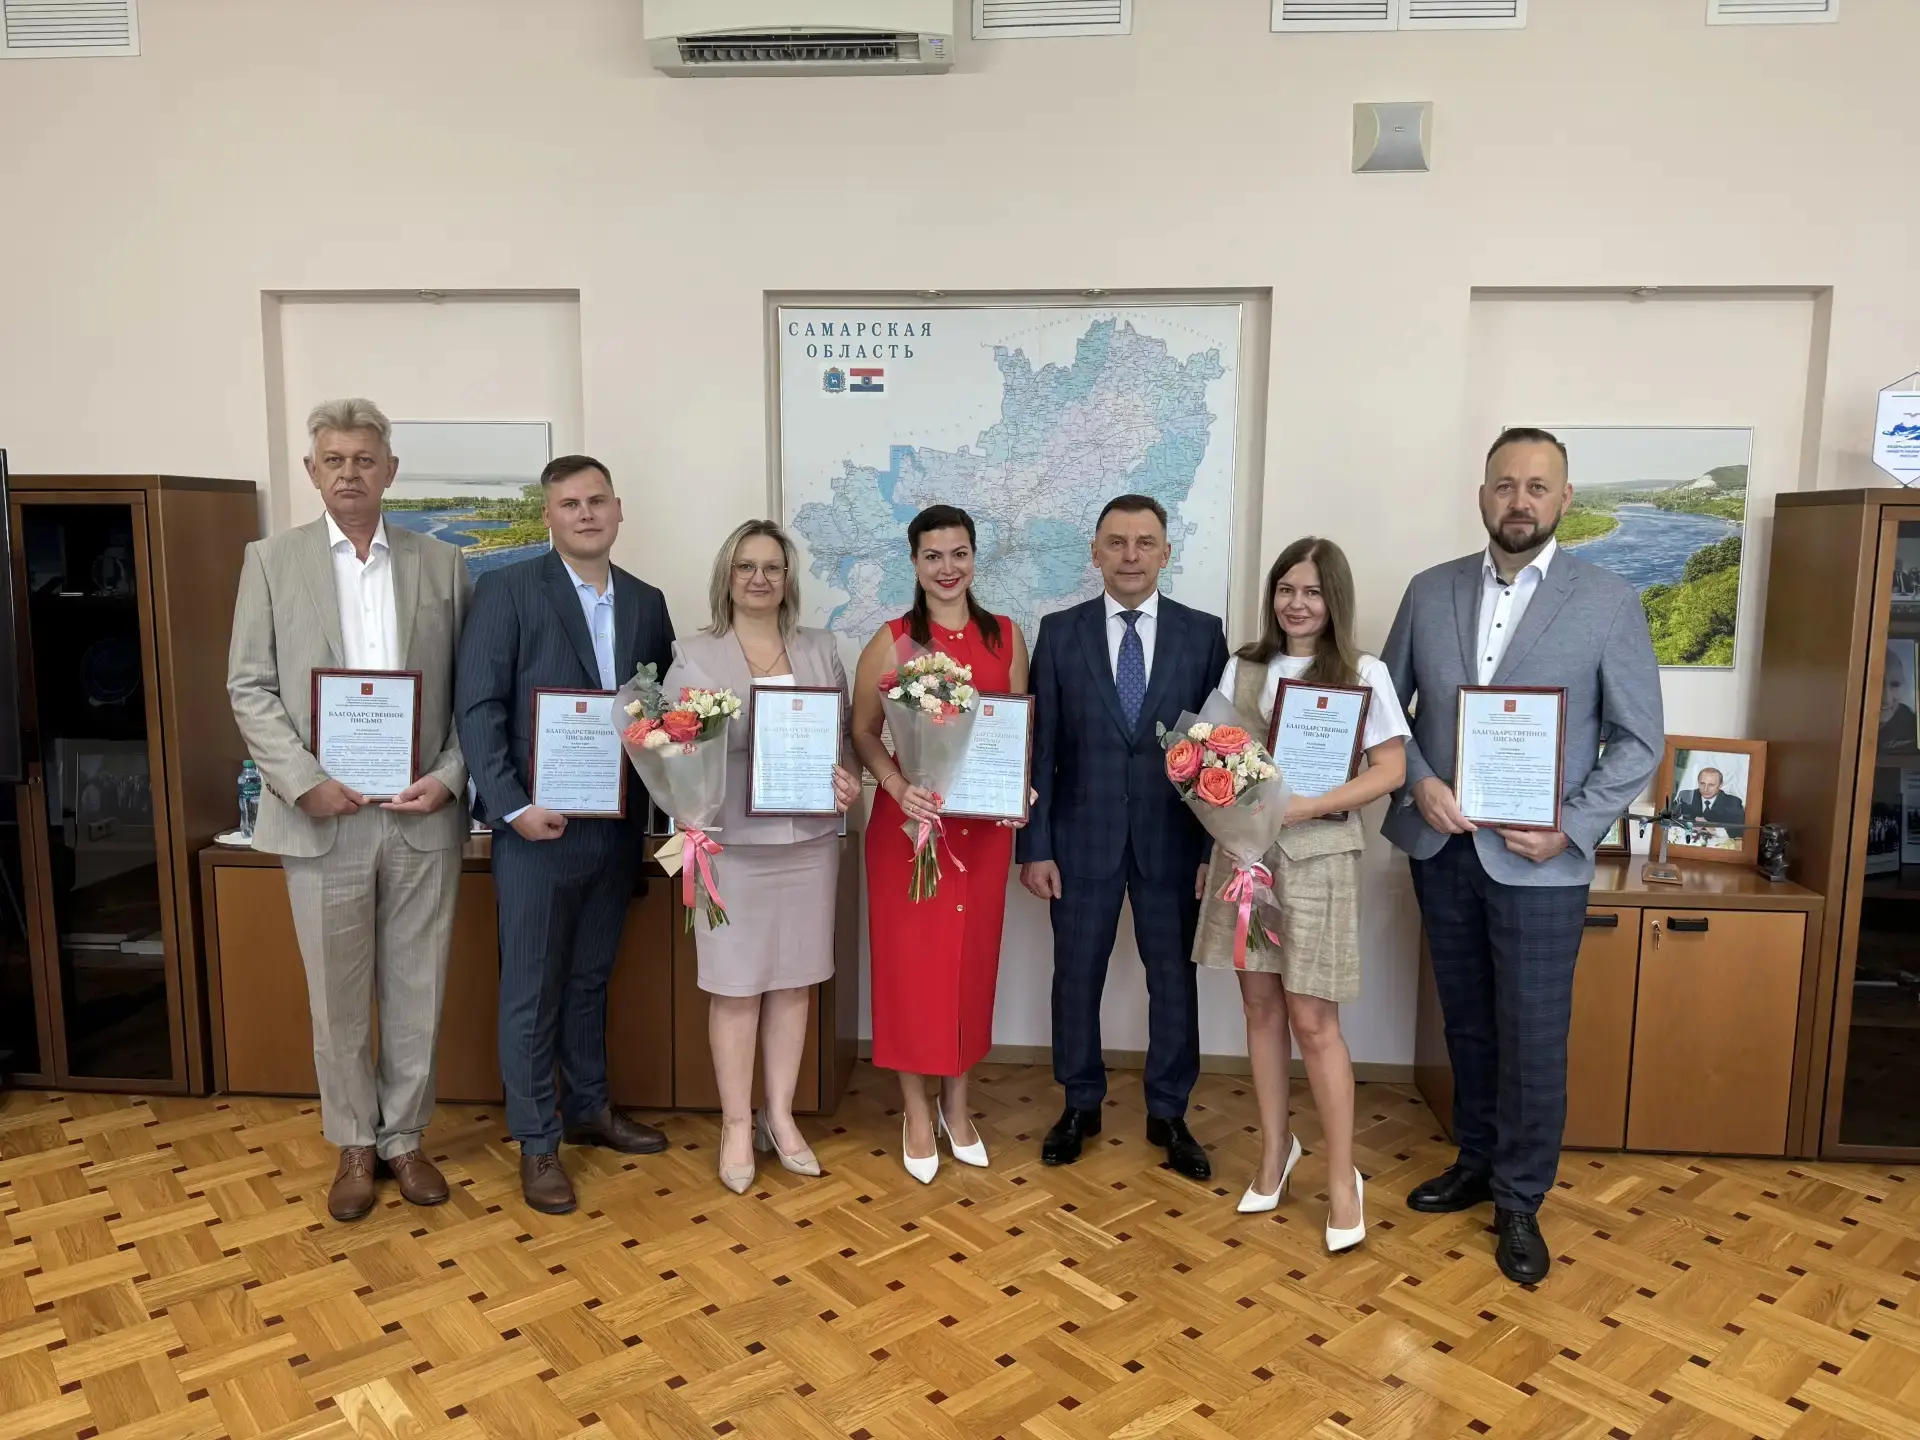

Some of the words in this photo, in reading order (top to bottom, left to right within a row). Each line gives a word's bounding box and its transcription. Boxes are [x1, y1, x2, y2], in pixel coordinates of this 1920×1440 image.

[788, 321, 932, 337] САМАРСКАЯ
[806, 343, 914, 359] ОБЛАСТЬ
[546, 728, 615, 736] БЛАГОДАРСТВЕННОЕ
[1286, 722, 1349, 734] БЛАГОДАРСТВЕННОЕ
[1472, 729, 1548, 737] БЛАГОДАРСТВЕННОЕ
[1303, 731, 1330, 739] ПИСЬМО
